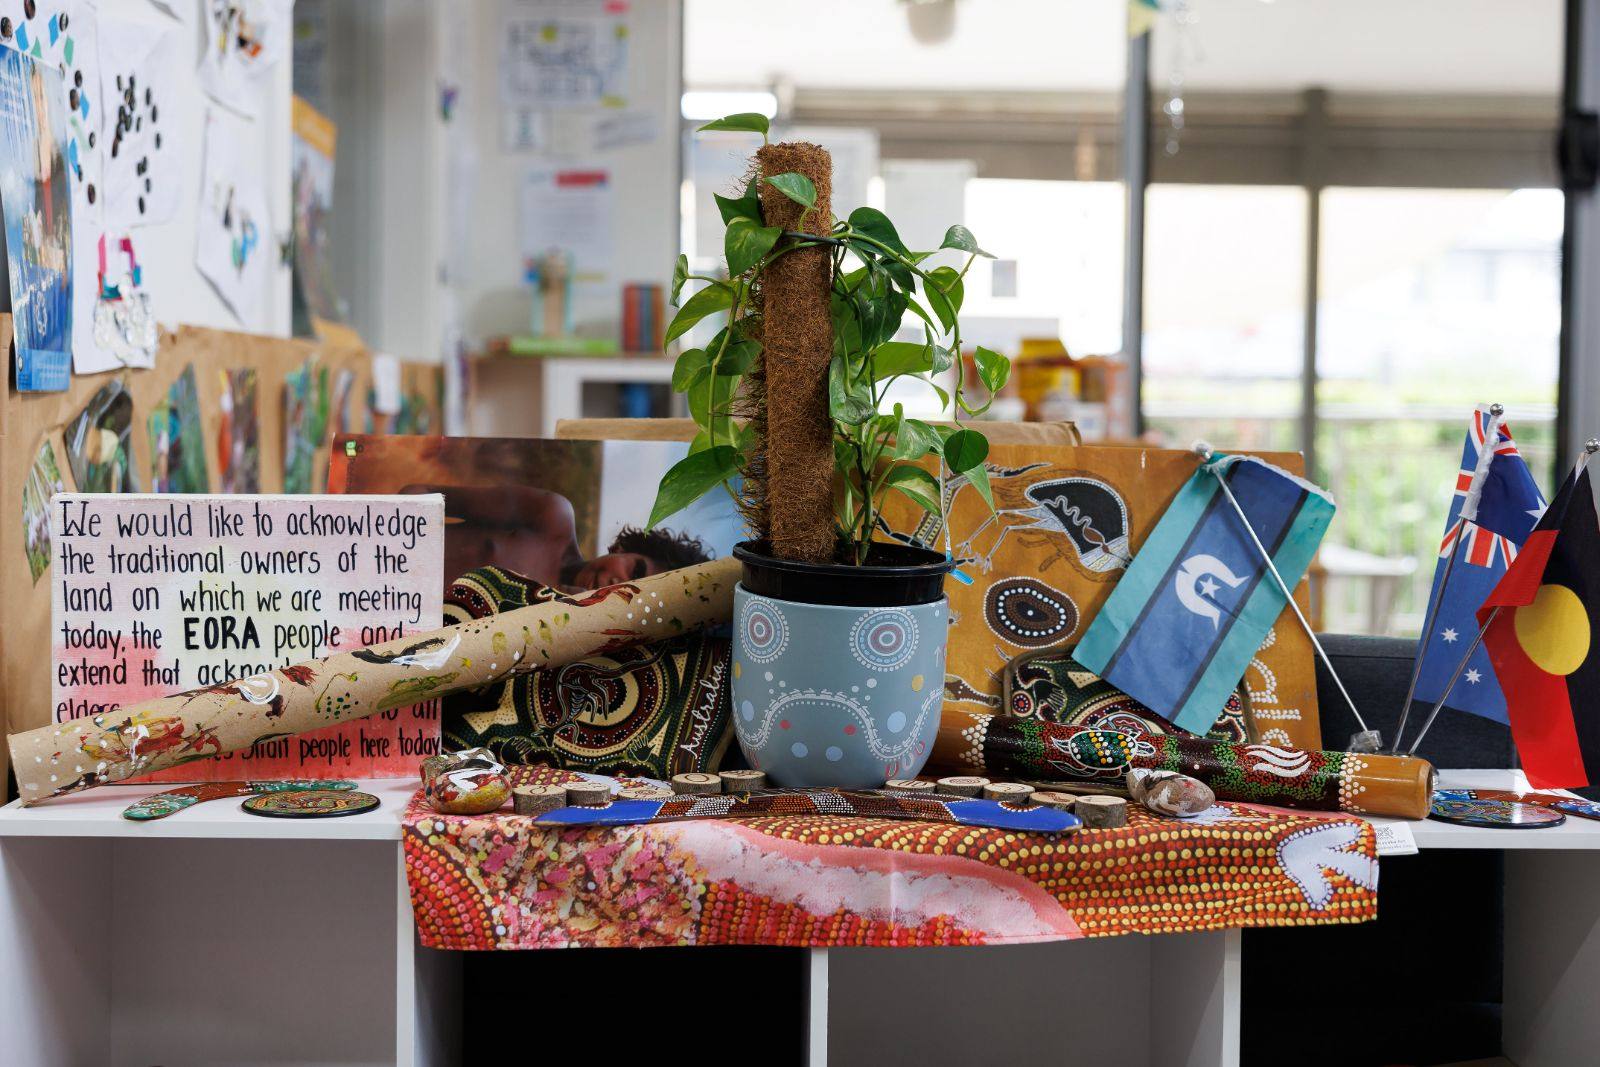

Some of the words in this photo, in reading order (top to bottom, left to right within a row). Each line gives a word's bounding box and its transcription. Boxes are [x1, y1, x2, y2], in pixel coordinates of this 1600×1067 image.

[59, 500, 101, 538] We
[117, 503, 193, 538] would
[208, 504, 244, 538] like
[252, 502, 273, 538] to
[287, 505, 427, 549] acknowledge
[60, 542, 95, 575] the
[108, 544, 224, 574] traditional
[241, 550, 321, 574] owners
[338, 543, 358, 573] of
[375, 545, 409, 574] the
[63, 580, 113, 612] land
[132, 587, 160, 612] on
[180, 580, 244, 612] which
[257, 590, 282, 612] we
[291, 589, 322, 612] are
[339, 585, 422, 624] meeting
[132, 620, 163, 650] the
[184, 616, 261, 650] EORA
[274, 620, 341, 660] people
[361, 620, 403, 646] and
[58, 657, 127, 687] extend
[142, 658, 181, 686] that
[680, 660, 724, 760] Australia
[300, 731, 350, 767] people
[360, 728, 390, 758] here
